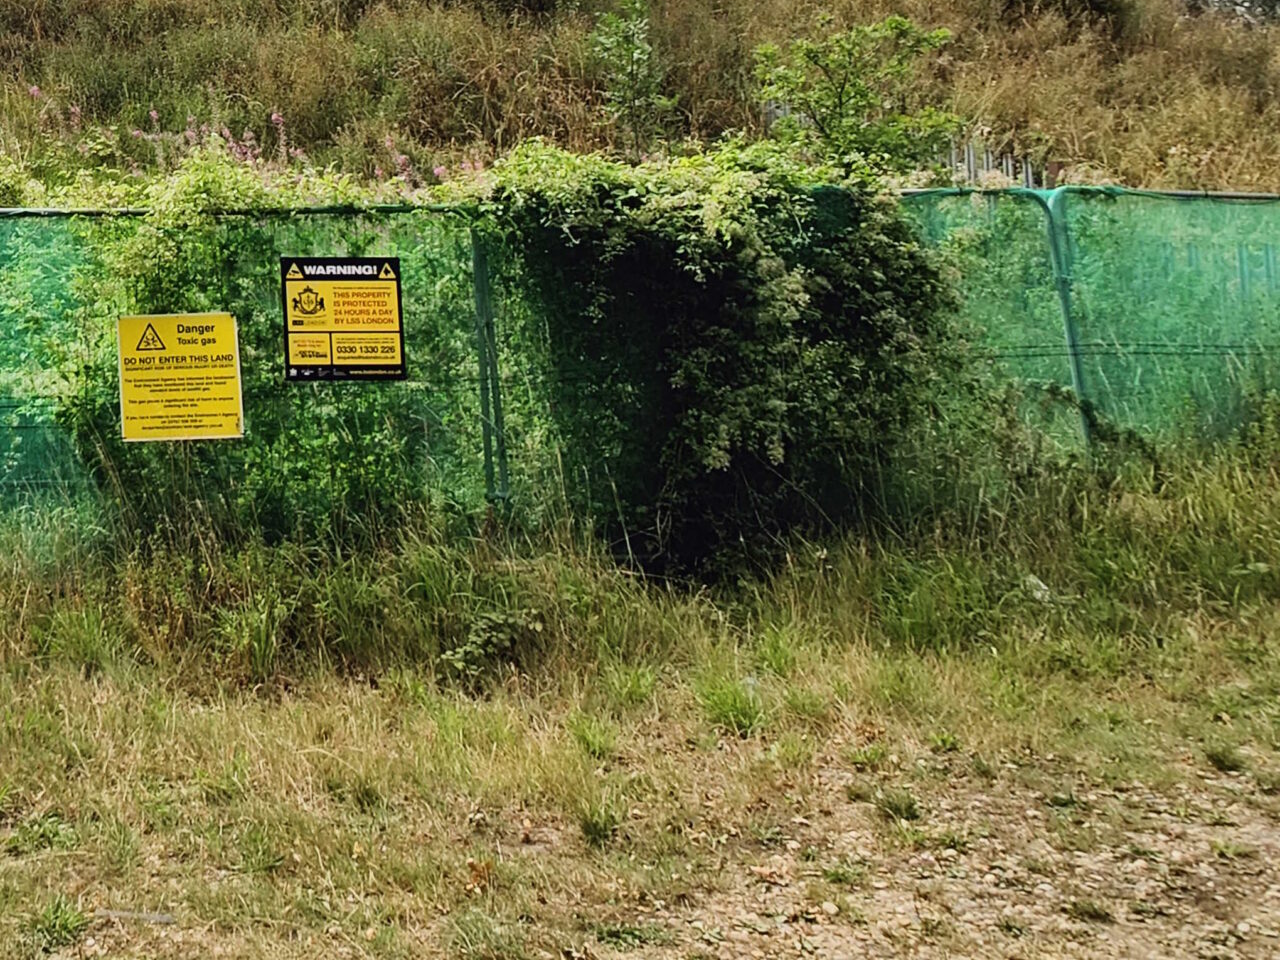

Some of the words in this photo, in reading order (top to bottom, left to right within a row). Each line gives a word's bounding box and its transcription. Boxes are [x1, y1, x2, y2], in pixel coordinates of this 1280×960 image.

[304, 265, 377, 275] WARNING!
[177, 324, 215, 334] Danger
[201, 338, 216, 346] gas
[159, 356, 186, 364] ENTER
